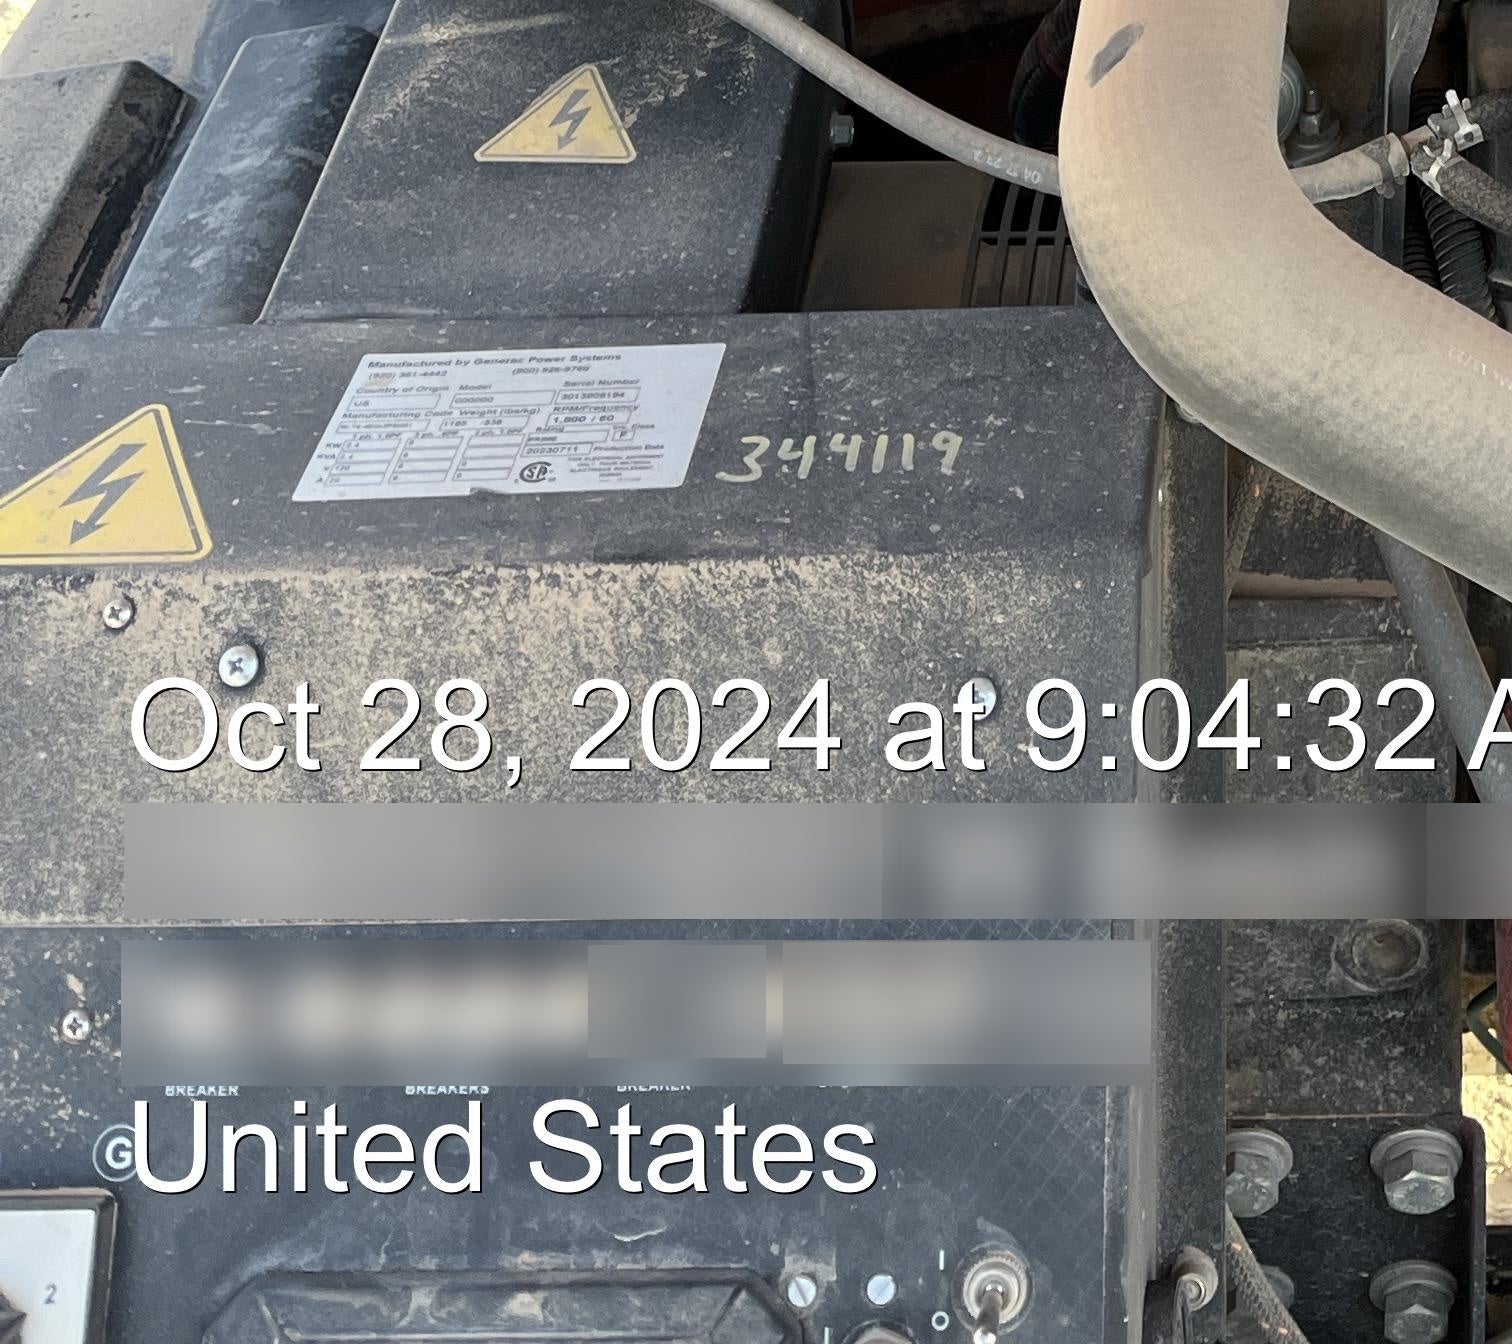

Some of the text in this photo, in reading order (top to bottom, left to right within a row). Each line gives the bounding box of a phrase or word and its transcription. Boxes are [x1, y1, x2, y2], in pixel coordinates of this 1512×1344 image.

[367, 359, 452, 368] Manufactured
[454, 359, 470, 367] by
[473, 357, 524, 365] Generac
[568, 354, 622, 363] Systems
[353, 387, 399, 397] Country
[415, 385, 450, 393] Origin
[457, 407, 540, 417] Weight (lbs/kg)
[552, 404, 639, 414] RPM/Frequency
[340, 411, 421, 421] Manufacturing
